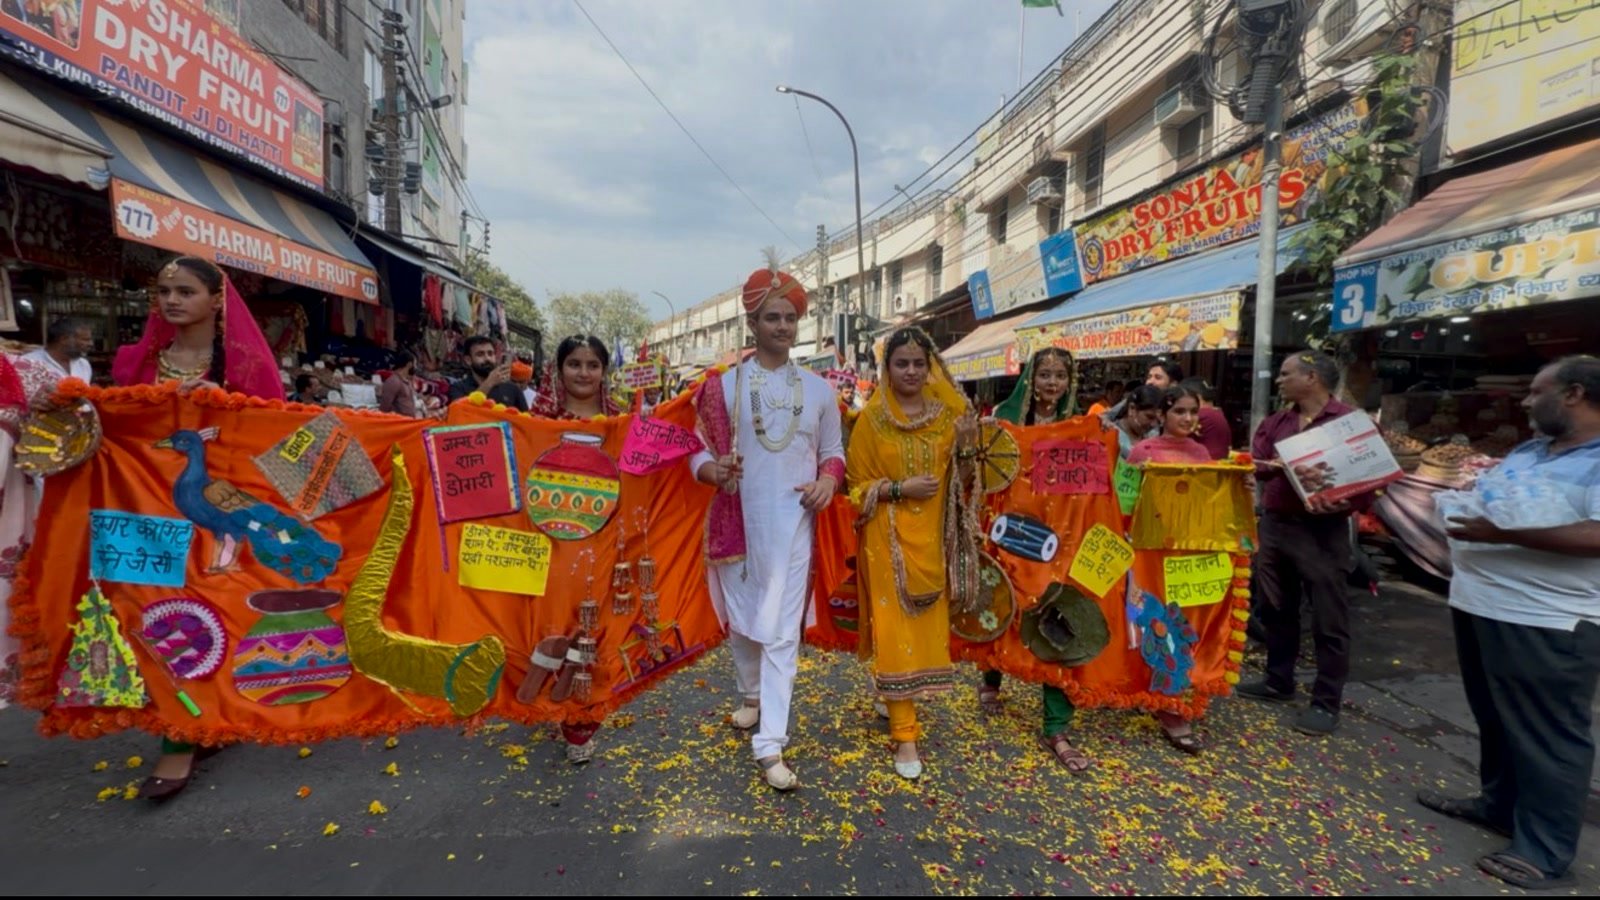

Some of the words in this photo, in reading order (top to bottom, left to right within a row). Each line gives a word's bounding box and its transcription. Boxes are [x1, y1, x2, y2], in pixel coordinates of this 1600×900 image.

[53, 58, 93, 86] KIND
[94, 5, 188, 83] DRY
[199, 69, 289, 142] FRUIT
[146, 0, 265, 99] SHARMA
[101, 54, 187, 113] PANDIT
[193, 106, 209, 126] JI
[216, 116, 233, 138] DI
[239, 128, 283, 164] HATTI
[1104, 224, 1160, 263] DRY
[1163, 169, 1307, 243] FRUITS
[1133, 168, 1240, 228] SONIA
[121, 204, 153, 231] 777
[160, 205, 184, 234] New
[182, 213, 276, 265] SHARMA
[280, 246, 313, 275] DRY
[317, 258, 358, 289] FRUIT
[215, 252, 269, 275] PANDIT
[1335, 270, 1359, 281] SHOP
[1361, 265, 1376, 278] NO
[1341, 283, 1364, 325] 3
[1082, 330, 1105, 349] DRY
[1107, 325, 1153, 347] FRUITS
[445, 470, 496, 497] डोगरी
